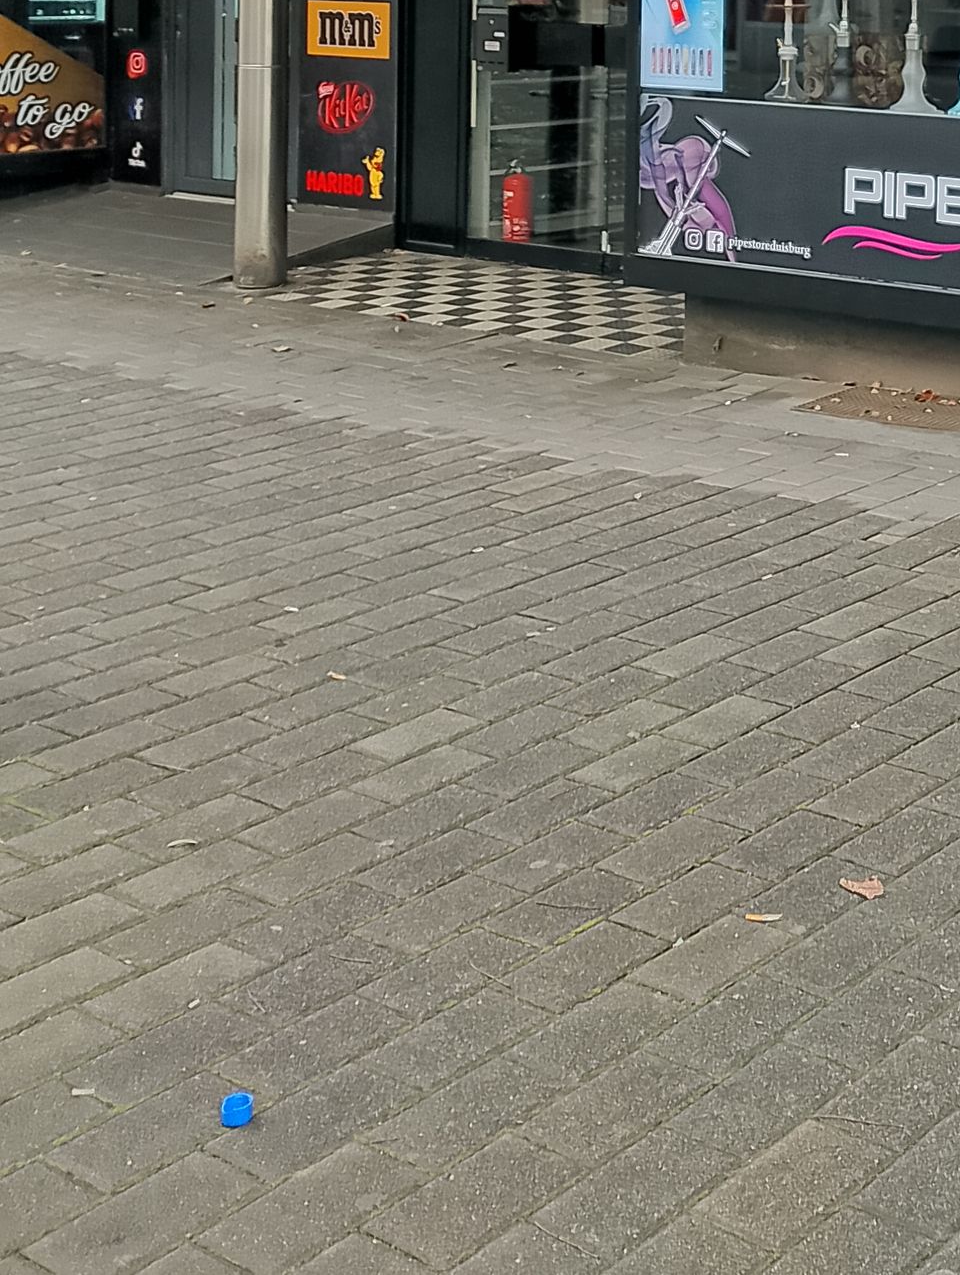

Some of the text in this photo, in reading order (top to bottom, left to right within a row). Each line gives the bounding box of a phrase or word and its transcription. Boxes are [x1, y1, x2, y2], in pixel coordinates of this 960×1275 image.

[0, 52, 60, 95] ffee
[16, 95, 95, 139] to go
[306, 170, 365, 197] HARIBO
[728, 236, 812, 259] pipestoreduisburg
